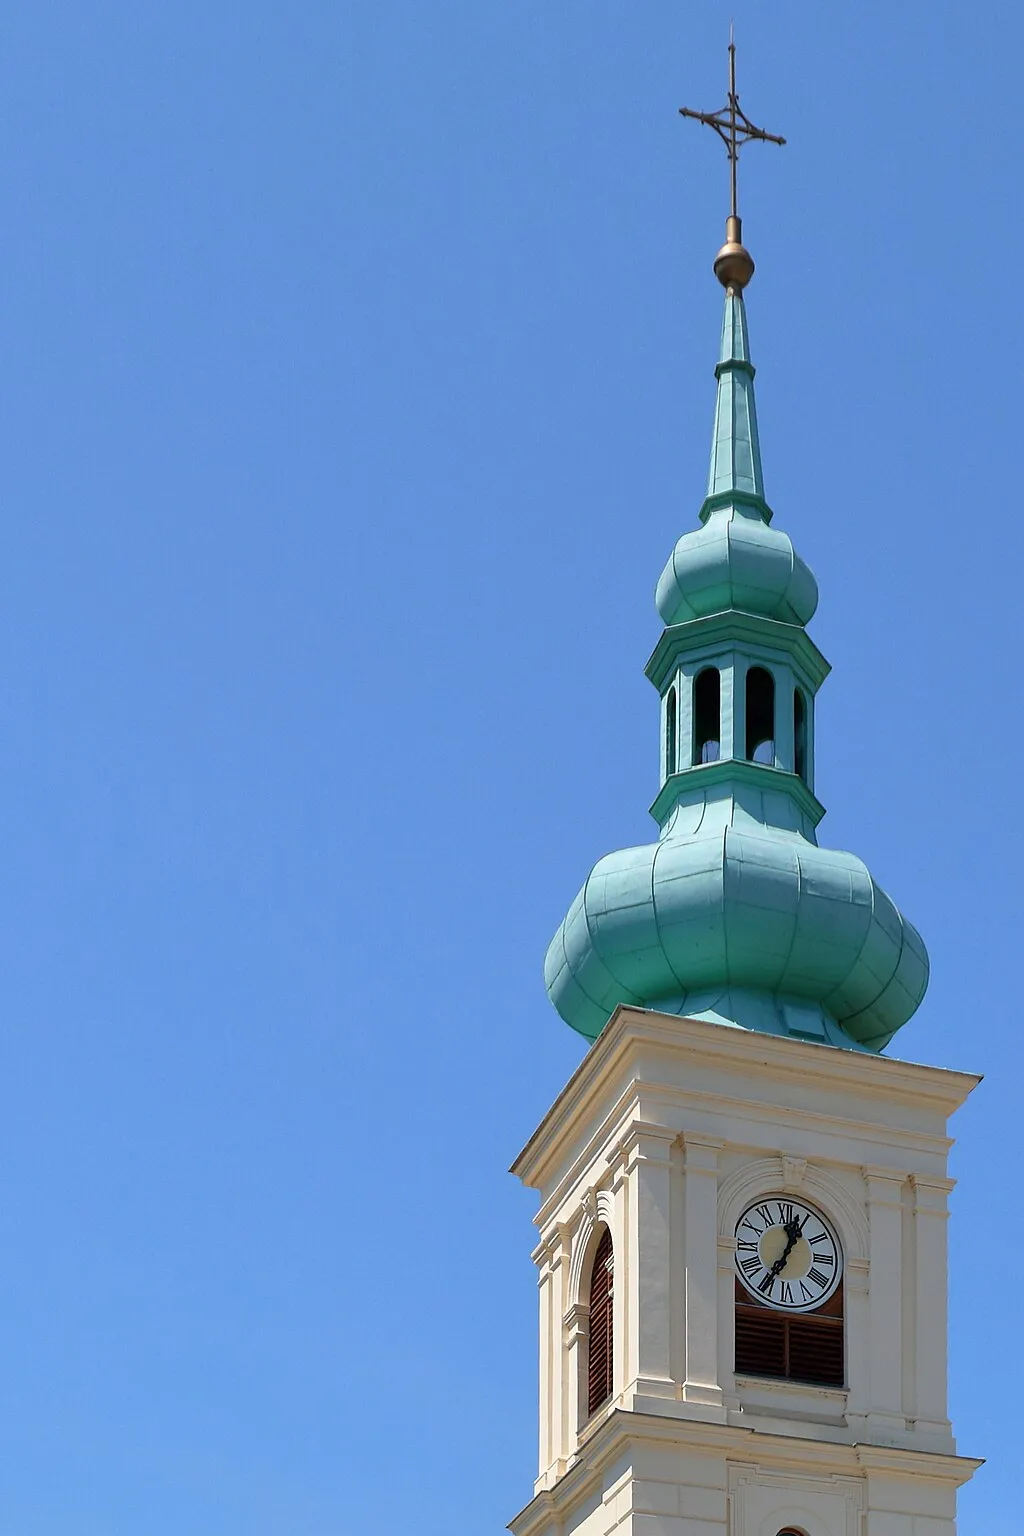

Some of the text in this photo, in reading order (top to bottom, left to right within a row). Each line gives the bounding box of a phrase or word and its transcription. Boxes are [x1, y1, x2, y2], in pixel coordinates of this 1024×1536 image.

[755, 1205, 775, 1228] XI
[776, 1203, 793, 1225] XII
[742, 1218, 763, 1237] X
[737, 1238, 758, 1252] IX
[808, 1232, 828, 1245] II
[740, 1255, 763, 1279] VIII
[813, 1253, 833, 1266] III
[807, 1267, 829, 1289] IIII
[780, 1281, 794, 1303] VI
[799, 1280, 814, 1301] V
